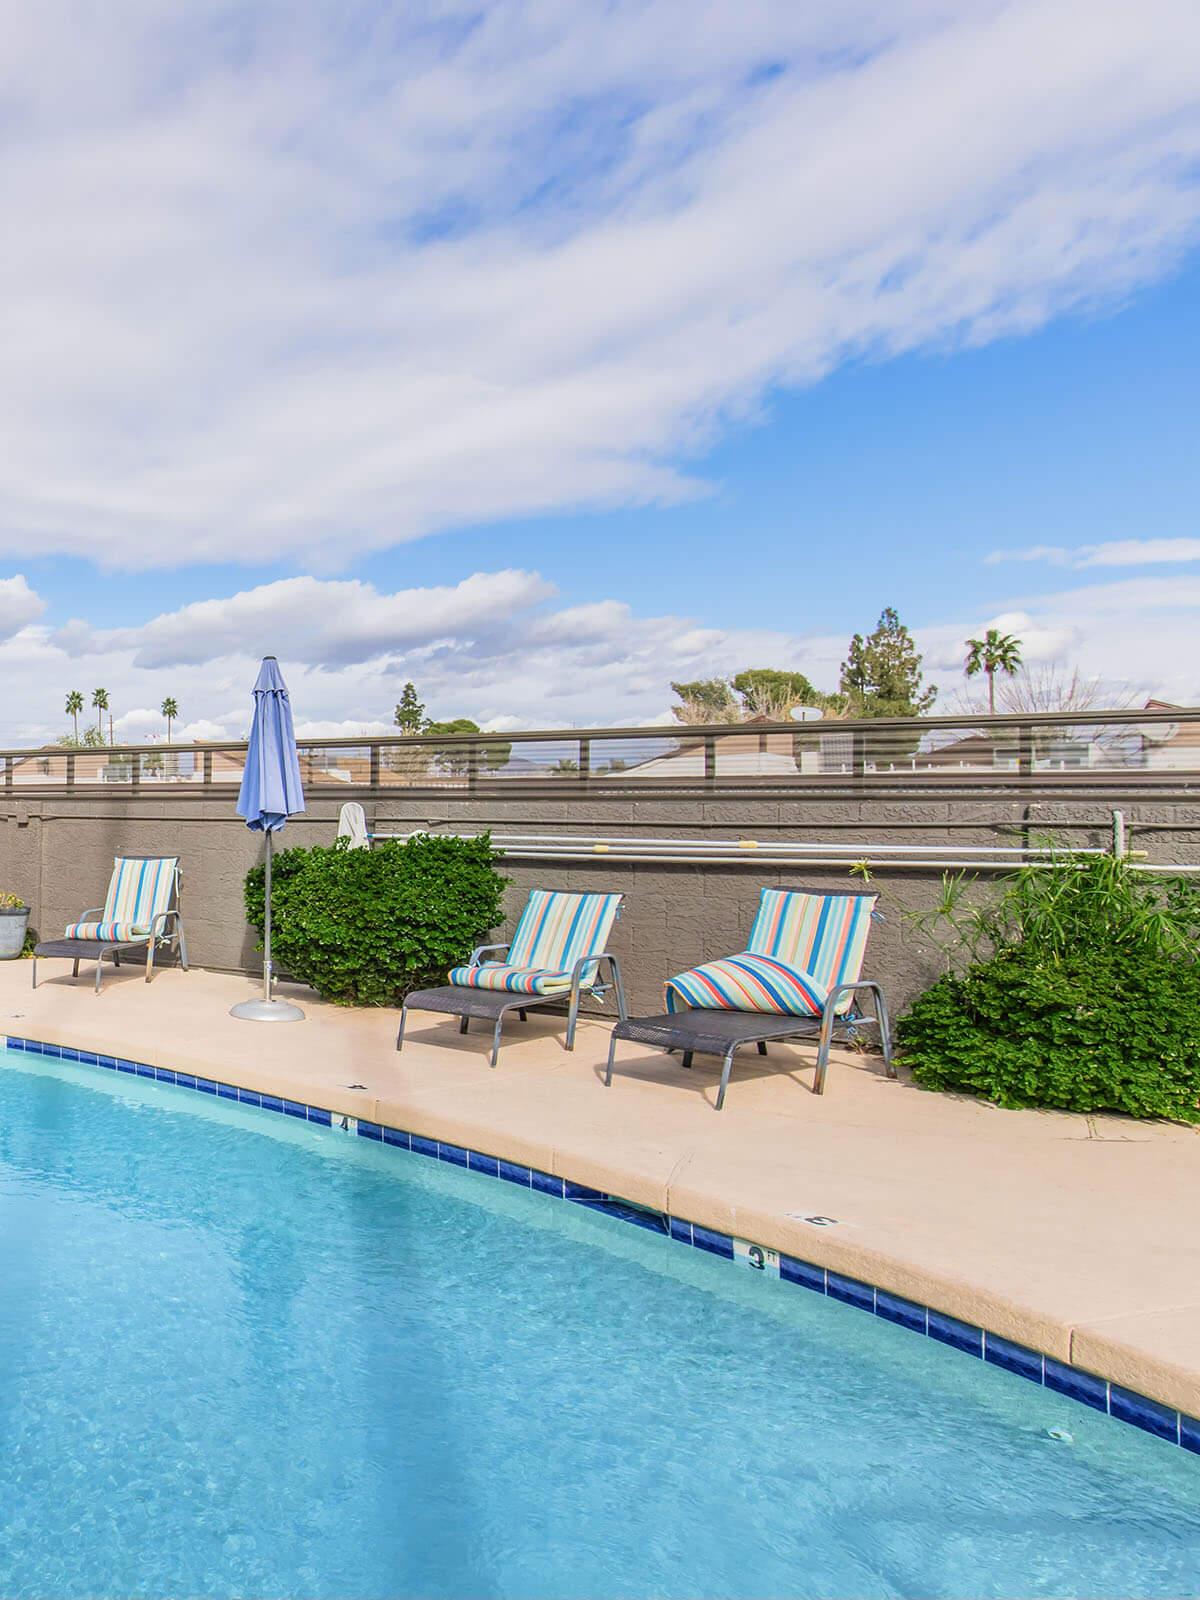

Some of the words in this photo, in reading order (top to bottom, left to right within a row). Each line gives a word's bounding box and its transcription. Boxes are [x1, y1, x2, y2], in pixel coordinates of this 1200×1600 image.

[340, 1116, 349, 1131] 4
[804, 1216, 839, 1226] 3
[748, 1246, 766, 1271] 3
